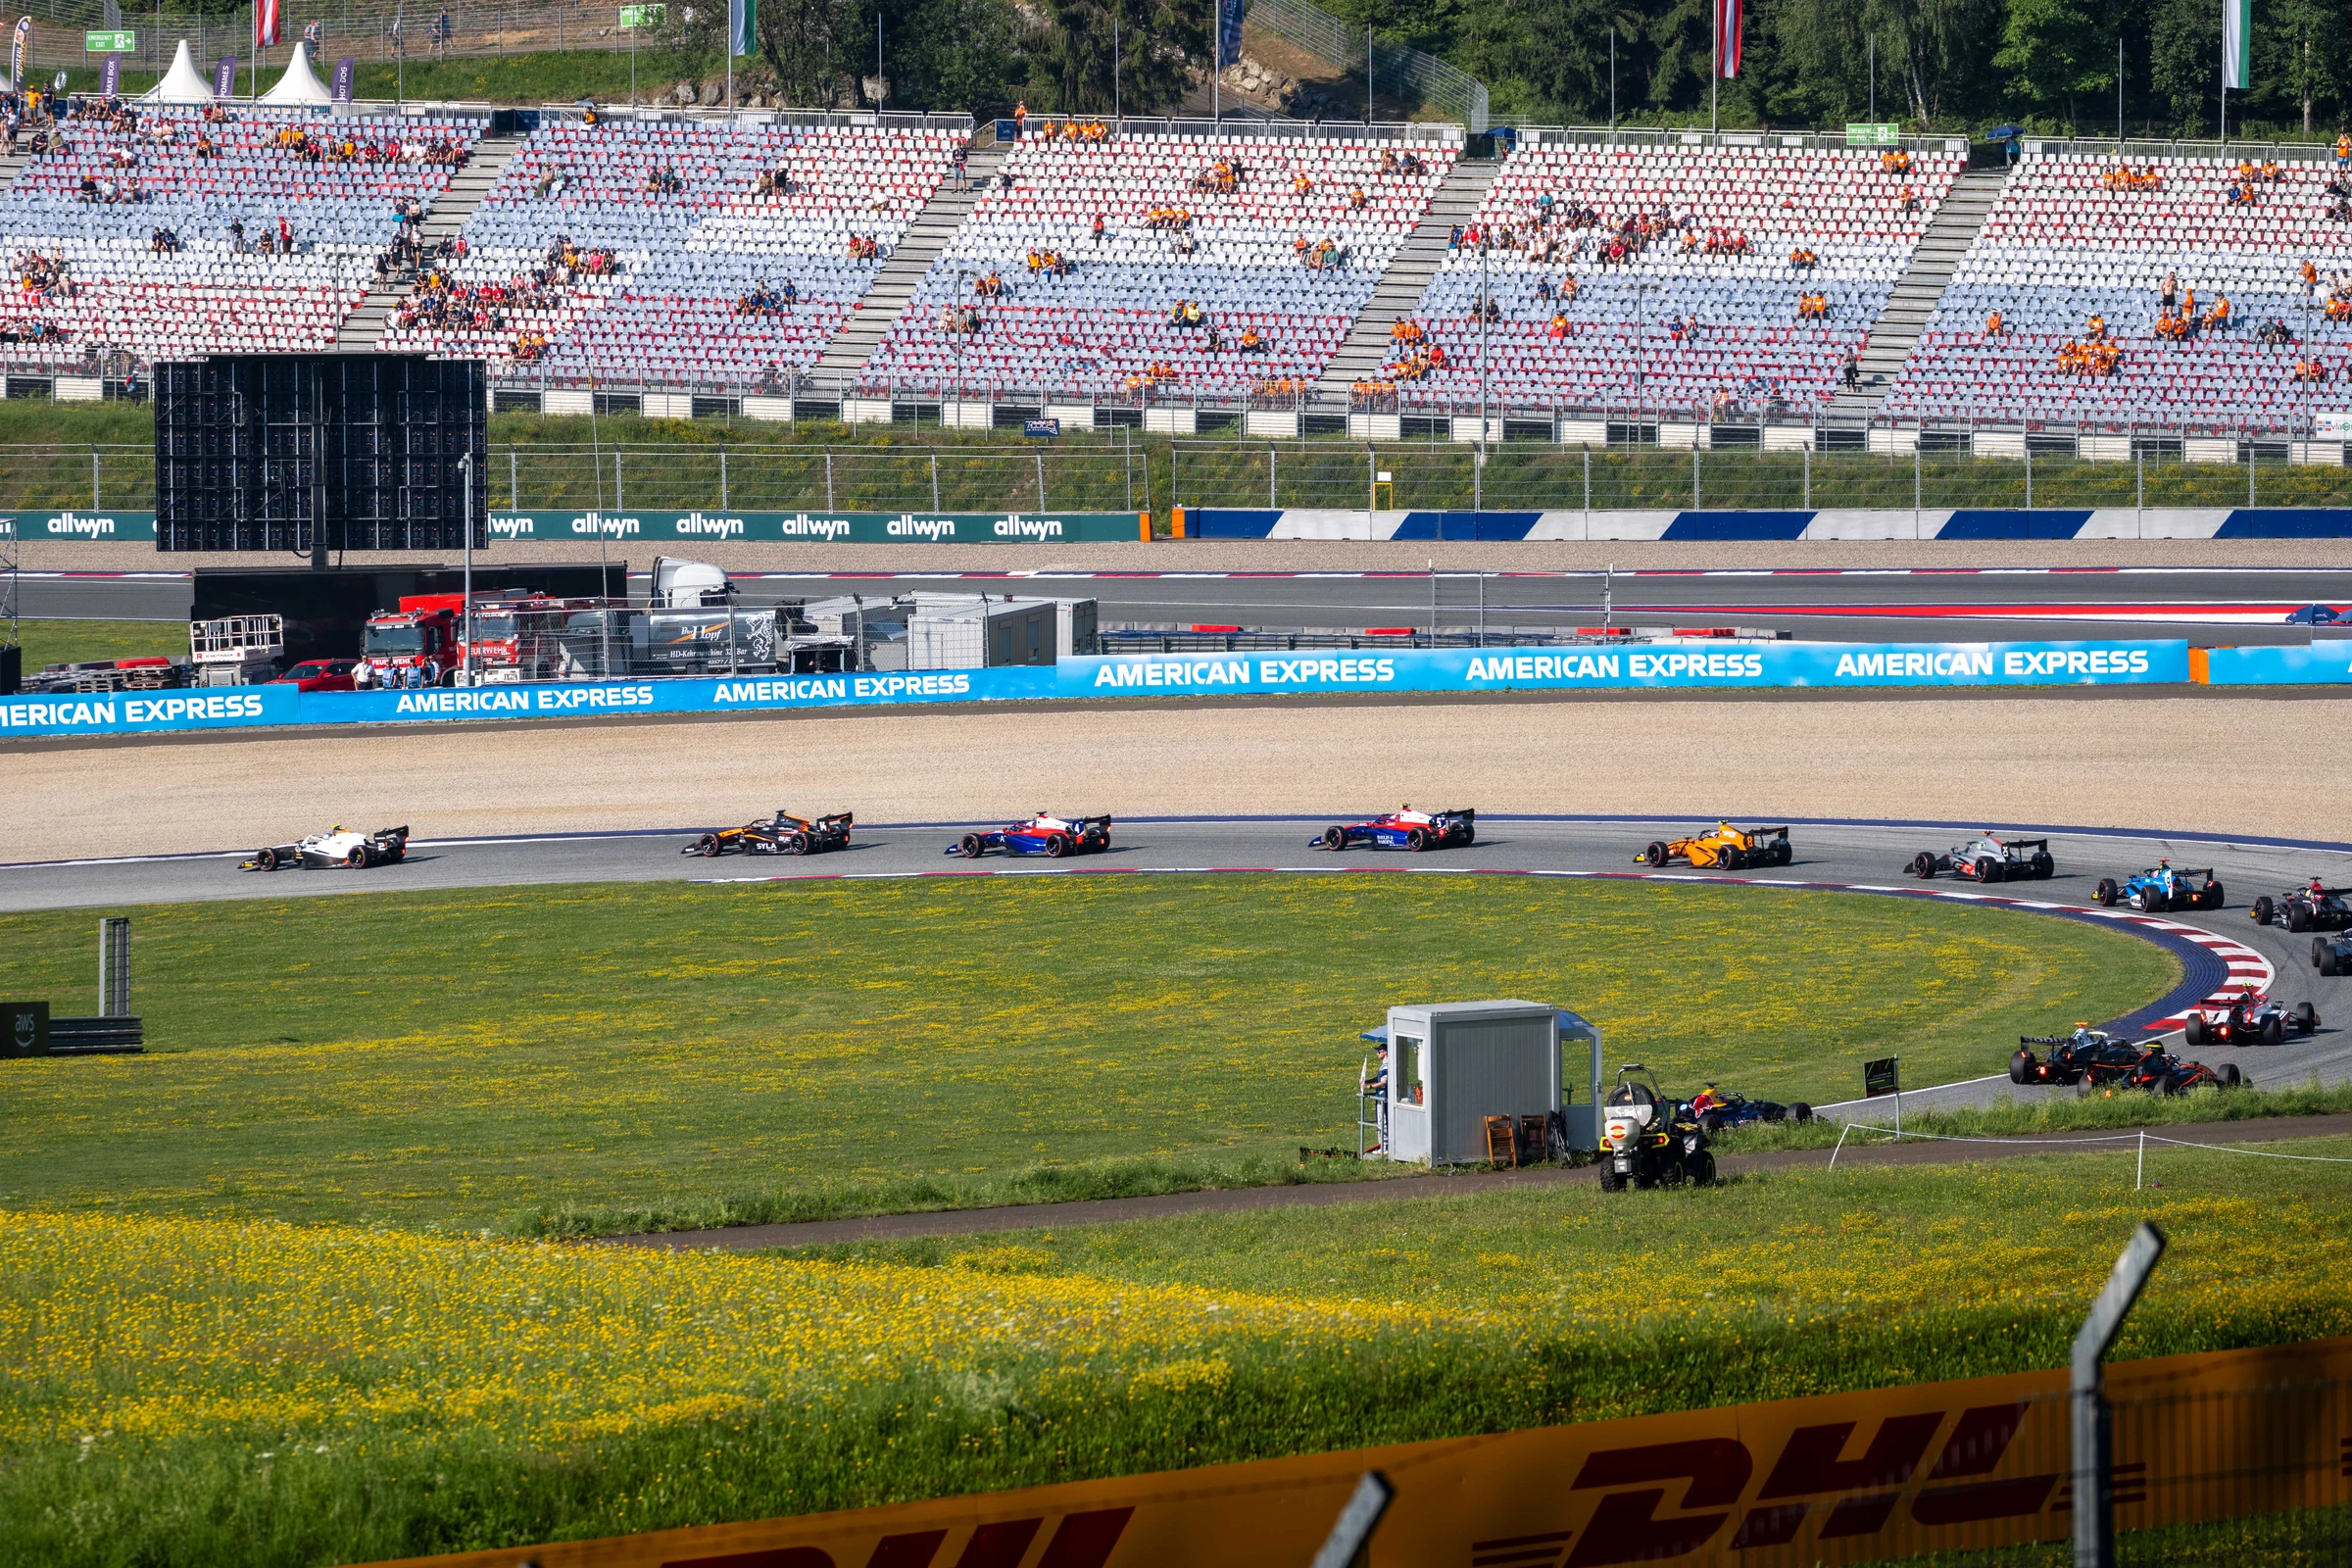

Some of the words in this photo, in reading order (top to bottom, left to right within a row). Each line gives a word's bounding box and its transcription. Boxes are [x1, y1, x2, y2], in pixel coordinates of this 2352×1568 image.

[220, 65, 229, 98] POMMES
[48, 513, 115, 538] allwyn
[488, 513, 534, 538] lwyn
[571, 513, 640, 538] allwyn
[676, 513, 744, 539] allwyn
[783, 514, 850, 540] allwyn
[887, 514, 956, 541] allwyn
[994, 515, 1063, 541] allwyn
[691, 625, 722, 641] Hopf
[1096, 662, 1250, 687] AMERICAN
[1261, 659, 1395, 683] EXPRESS
[1466, 656, 1619, 680] AMERICAN
[1630, 654, 1763, 677] EXPRESS
[1836, 652, 1993, 676] AMERICAN
[2005, 650, 2149, 674] EXPRESS
[396, 691, 529, 713] AMERICAN
[538, 686, 655, 710] EXPRESS
[713, 679, 846, 703] AMERICAN
[855, 674, 970, 697] EXPRESS
[125, 694, 264, 722] EXPRESS
[1436, 817, 1442, 828] 5
[1746, 836, 1753, 847] 8
[16, 1013, 34, 1032] aws
[1564, 1401, 2059, 1568] DHL
